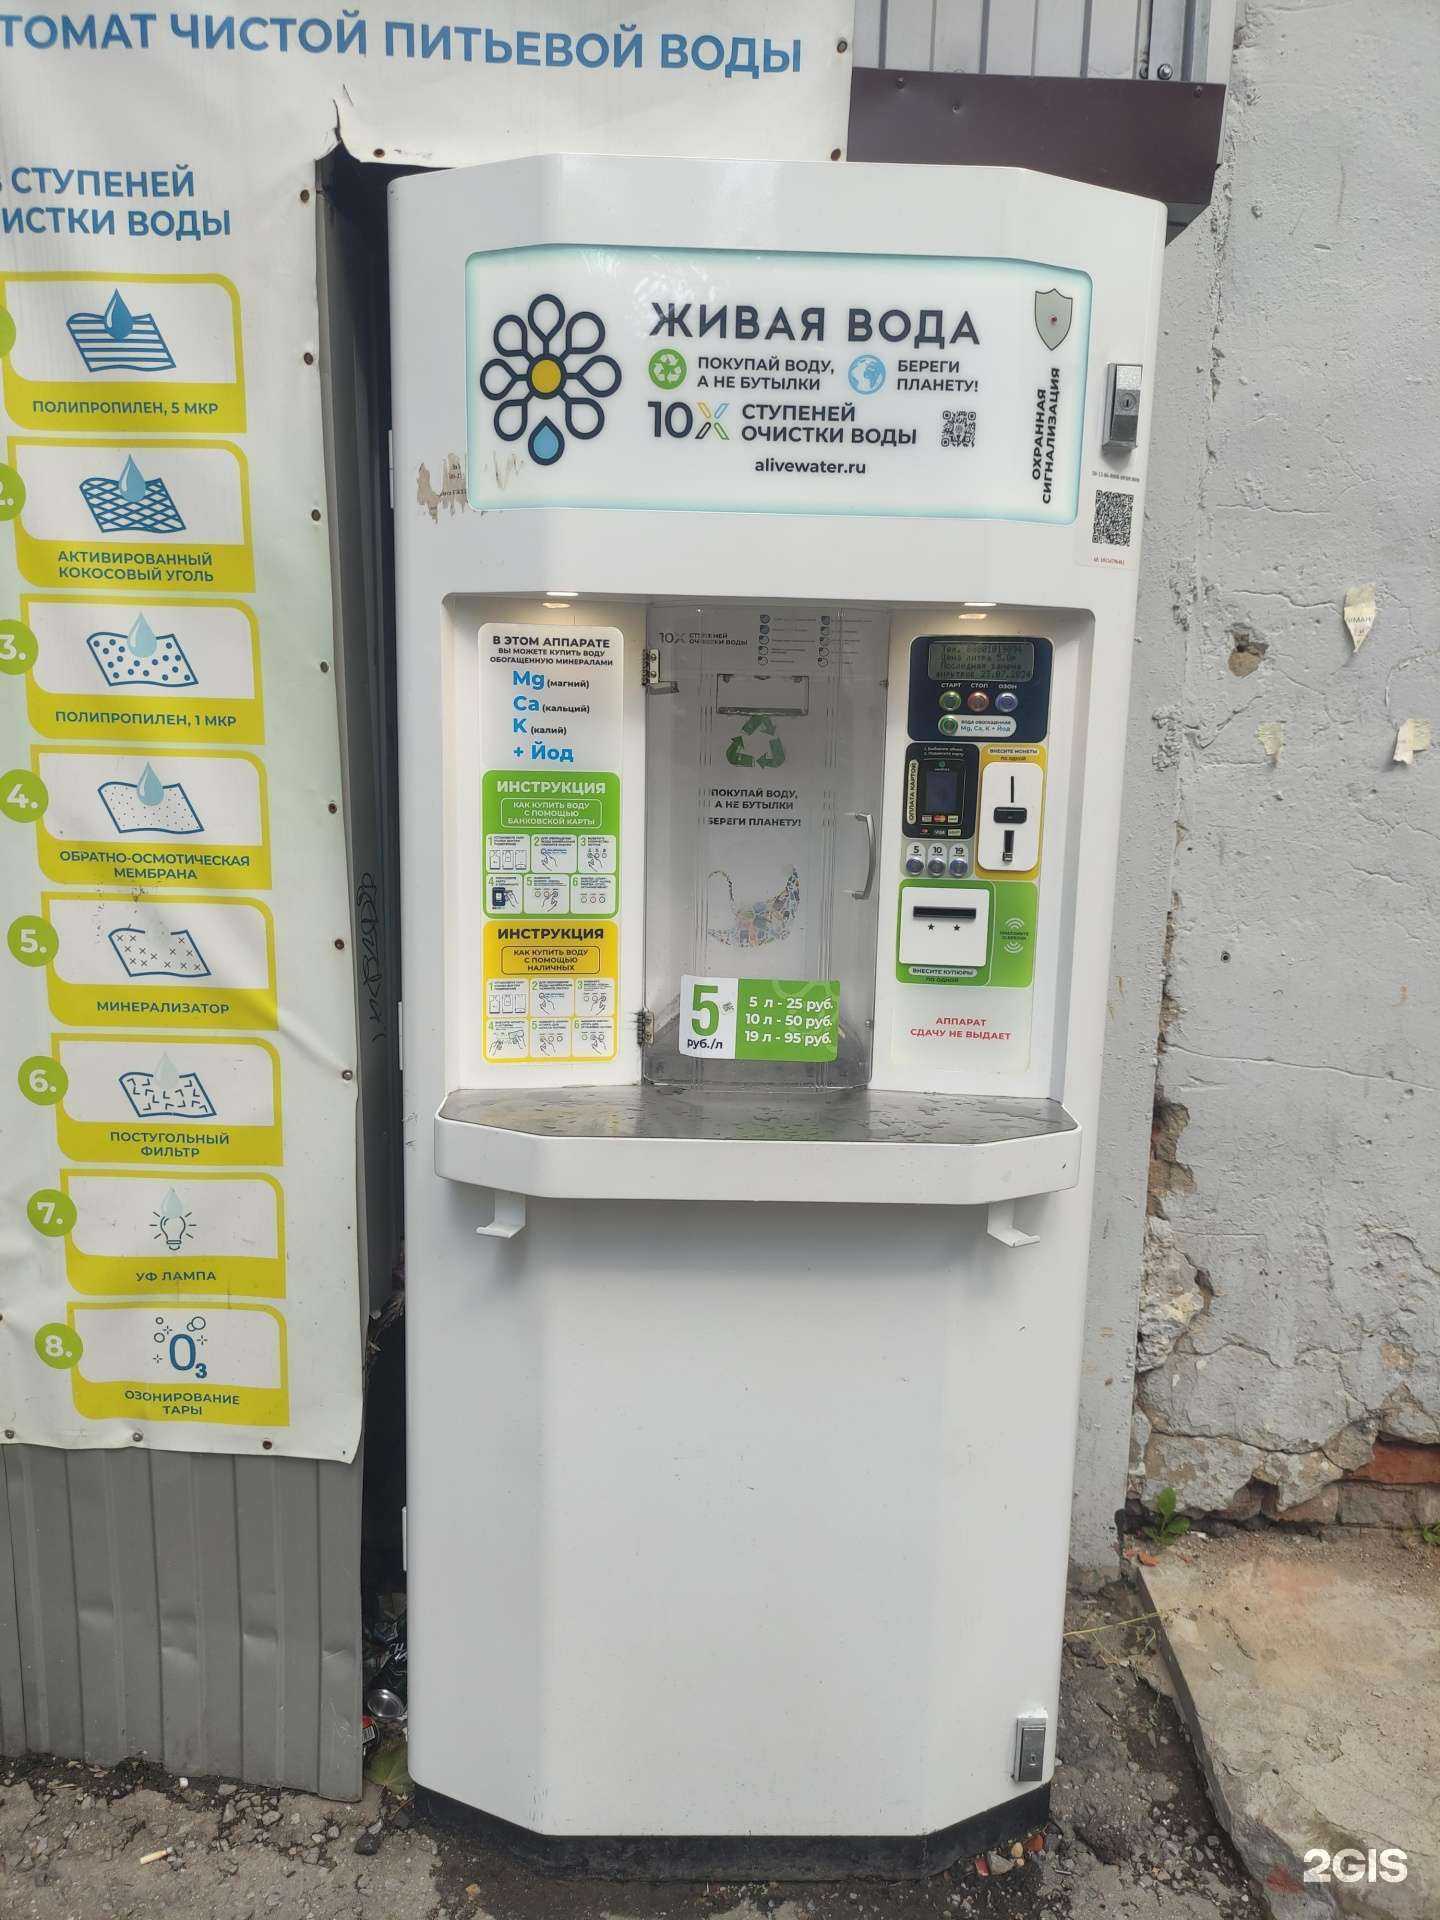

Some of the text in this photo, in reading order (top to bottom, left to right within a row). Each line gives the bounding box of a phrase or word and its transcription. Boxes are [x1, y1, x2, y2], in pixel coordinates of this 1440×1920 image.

[171, 10, 367, 55] ЧИСТОЙ
[385, 21, 643, 69] ПИТЬЕВОЙ
[661, 34, 801, 79] ВОДЫ
[11, 164, 195, 198] СТУПЕНЕЙ
[128, 210, 231, 241] ВОДЫ
[649, 302, 981, 350] ЖИВАЯ ВОДА
[698, 356, 834, 376] ПОКУПАЙ ВОДУ,
[897, 360, 960, 374] БЕРЕГИ
[697, 376, 820, 391] А НЕ БУТЫЛКИ
[897, 378, 979, 393] ПЛАНЕТУ!
[33, 400, 219, 415] ПОЛИПРОПИЛЕН, 5 МКР
[742, 402, 856, 422] СТУПЕНЕЙ
[741, 424, 917, 447] ОЧИСТКИ ВОДЫ
[1032, 388, 1047, 480] ОХРАННАЯ
[1043, 367, 1060, 504] СИГНАЛИЗАЦИЯ
[755, 458, 867, 475] alivewater.ru
[58, 550, 213, 566] АКТИВИРОВАННЫЙ
[59, 566, 214, 582] КОКОСОВЫЙ УГОЛЬ
[0, 634, 27, 660] 3.
[493, 635, 610, 648] В ЭТОМ АППАРАТЕ
[490, 656, 613, 666] ОБОГАЩЕННУЮ МИНЕРАЛАМИ
[513, 671, 590, 690] Mg (магний)
[513, 695, 590, 714] Ca (кальций)
[55, 711, 236, 727] ПОЛИПРОПИЛЕН, 1 МКР
[513, 718, 567, 735] K (калий)
[513, 741, 574, 762] + Йод
[496, 780, 606, 794] ИНСТРУКЦИЯ
[711, 787, 798, 799] ПОКУПАЙ ВОДУ,
[7, 784, 38, 808] 4.
[567, 802, 590, 810] ВОДУ
[715, 801, 794, 810] А НЕ БУТЫЛКИ
[908, 792, 916, 820] ОПЛАТА
[508, 817, 565, 825] БАНКОВСКОЙ
[532, 810, 579, 818] ПОМОЩЬЮ
[933, 846, 942, 854] 10
[60, 850, 250, 867] ОБРАТНО-ОСМОТИЧЕСКАЯ
[114, 868, 198, 880] МЕМБРАНА
[20, 929, 48, 954] 5.
[497, 928, 604, 941] ИНСТРУКЦИЯ
[97, 1001, 230, 1015] МИНЕРАЛИЗАТОР
[691, 984, 719, 1037] 5
[749, 997, 758, 1008] 5
[763, 1000, 774, 1009] л
[786, 998, 803, 1009] 25
[806, 996, 833, 1012] руб.
[745, 1013, 760, 1025] 10
[763, 1017, 773, 1025] л
[785, 1015, 802, 1026] 50
[805, 1014, 833, 1030] руб.
[936, 1017, 987, 1027] АППАРАТ
[744, 1030, 759, 1042] 19
[762, 1033, 772, 1042] л
[784, 1032, 801, 1043] 95
[804, 1031, 832, 1047] руб.
[910, 1028, 1012, 1040] СДАЧУ НЕ ВЫДАЕТ
[687, 1038, 723, 1050] руб./л
[29, 1069, 57, 1093] 6.
[110, 1131, 230, 1145] ПОСТУГОЛЬНЫЙ
[141, 1146, 200, 1158] ФИЛЬТР
[36, 1201, 64, 1225] 7.
[135, 1271, 216, 1282] УФ ЛАМПА
[44, 1335, 73, 1358] 8.
[124, 1390, 240, 1406] ОЗОНИРОВАНИЕ
[162, 1405, 203, 1416] ТАРЫ
